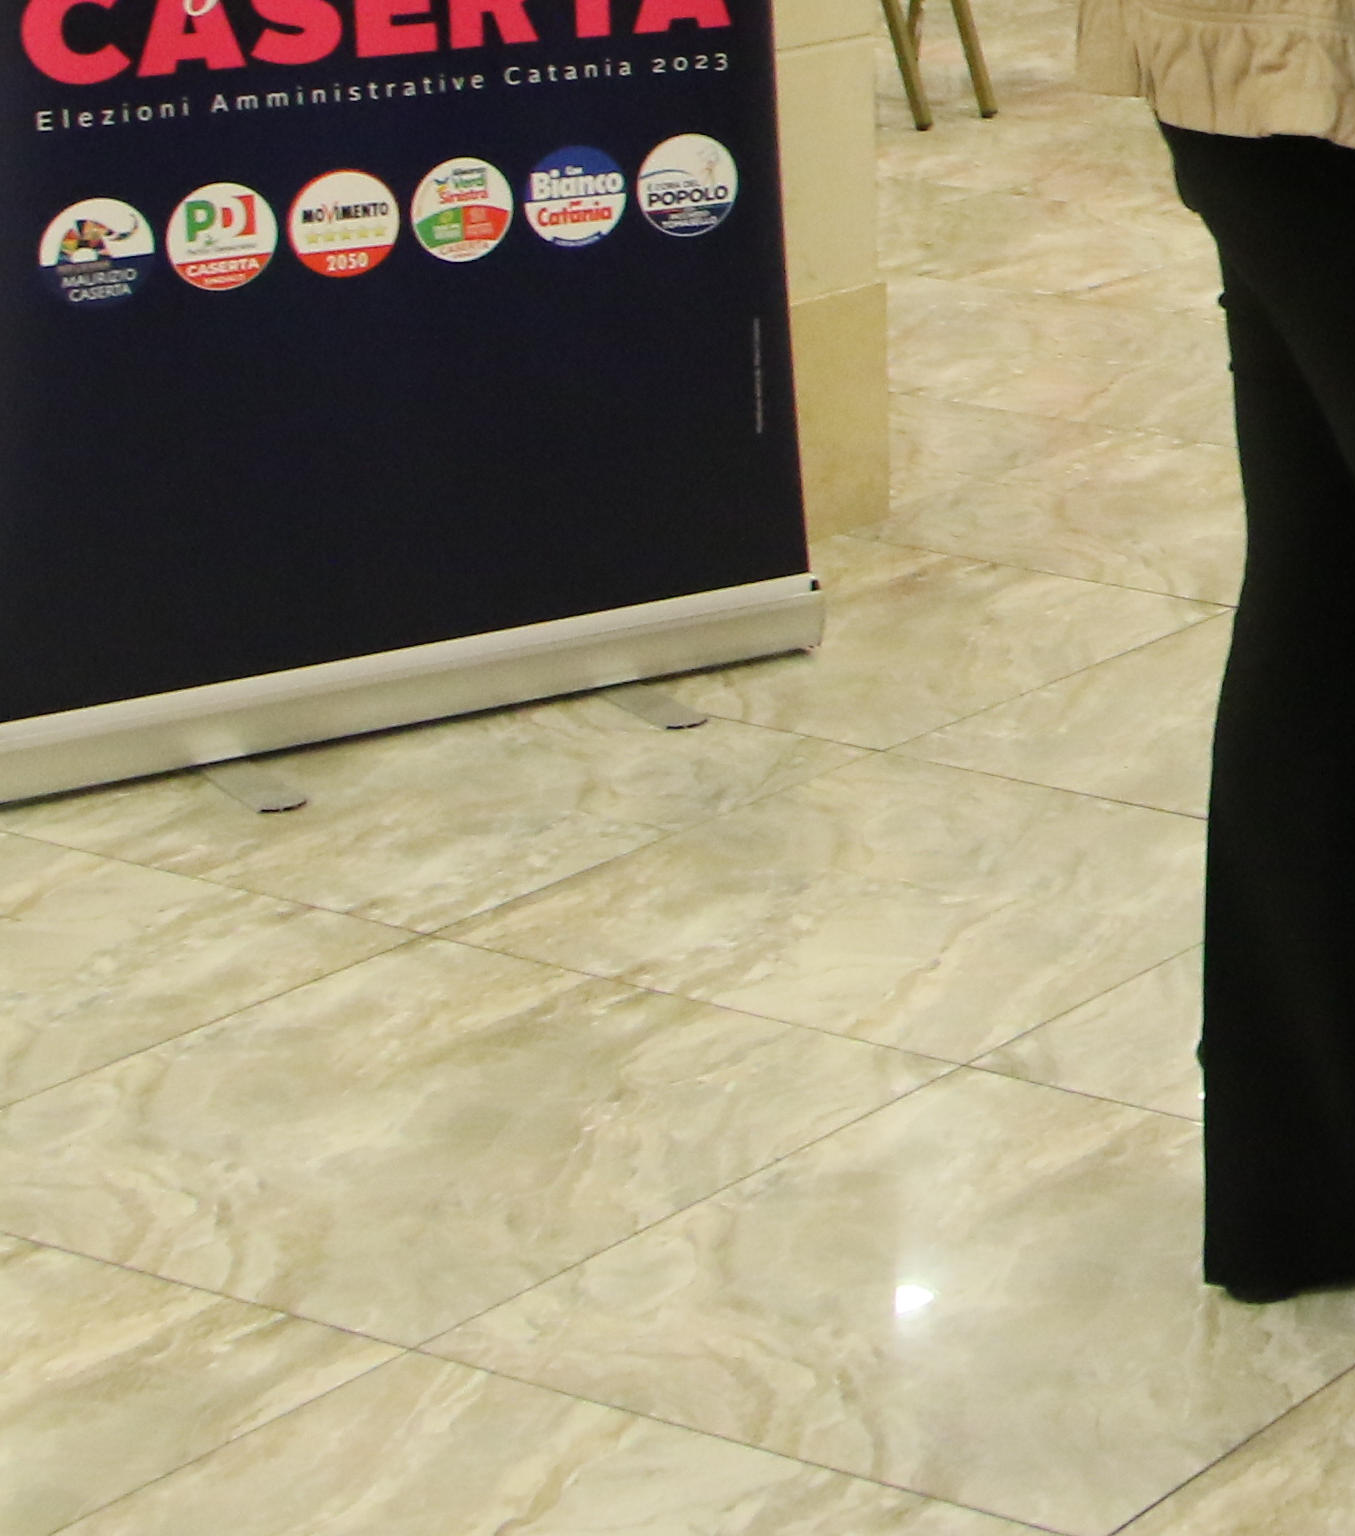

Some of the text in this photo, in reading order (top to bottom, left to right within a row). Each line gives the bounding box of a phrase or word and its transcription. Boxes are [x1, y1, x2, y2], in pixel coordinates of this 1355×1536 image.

[37, 52, 731, 132] Elezioni Amministrative Catania 2023
[530, 168, 625, 201] Bianco
[648, 184, 729, 208] POPOLO
[185, 194, 256, 242] PD
[302, 201, 389, 224] MOVIMENTO
[537, 202, 613, 227] Catania
[185, 257, 260, 278] CASERTA
[326, 252, 369, 272] 2050
